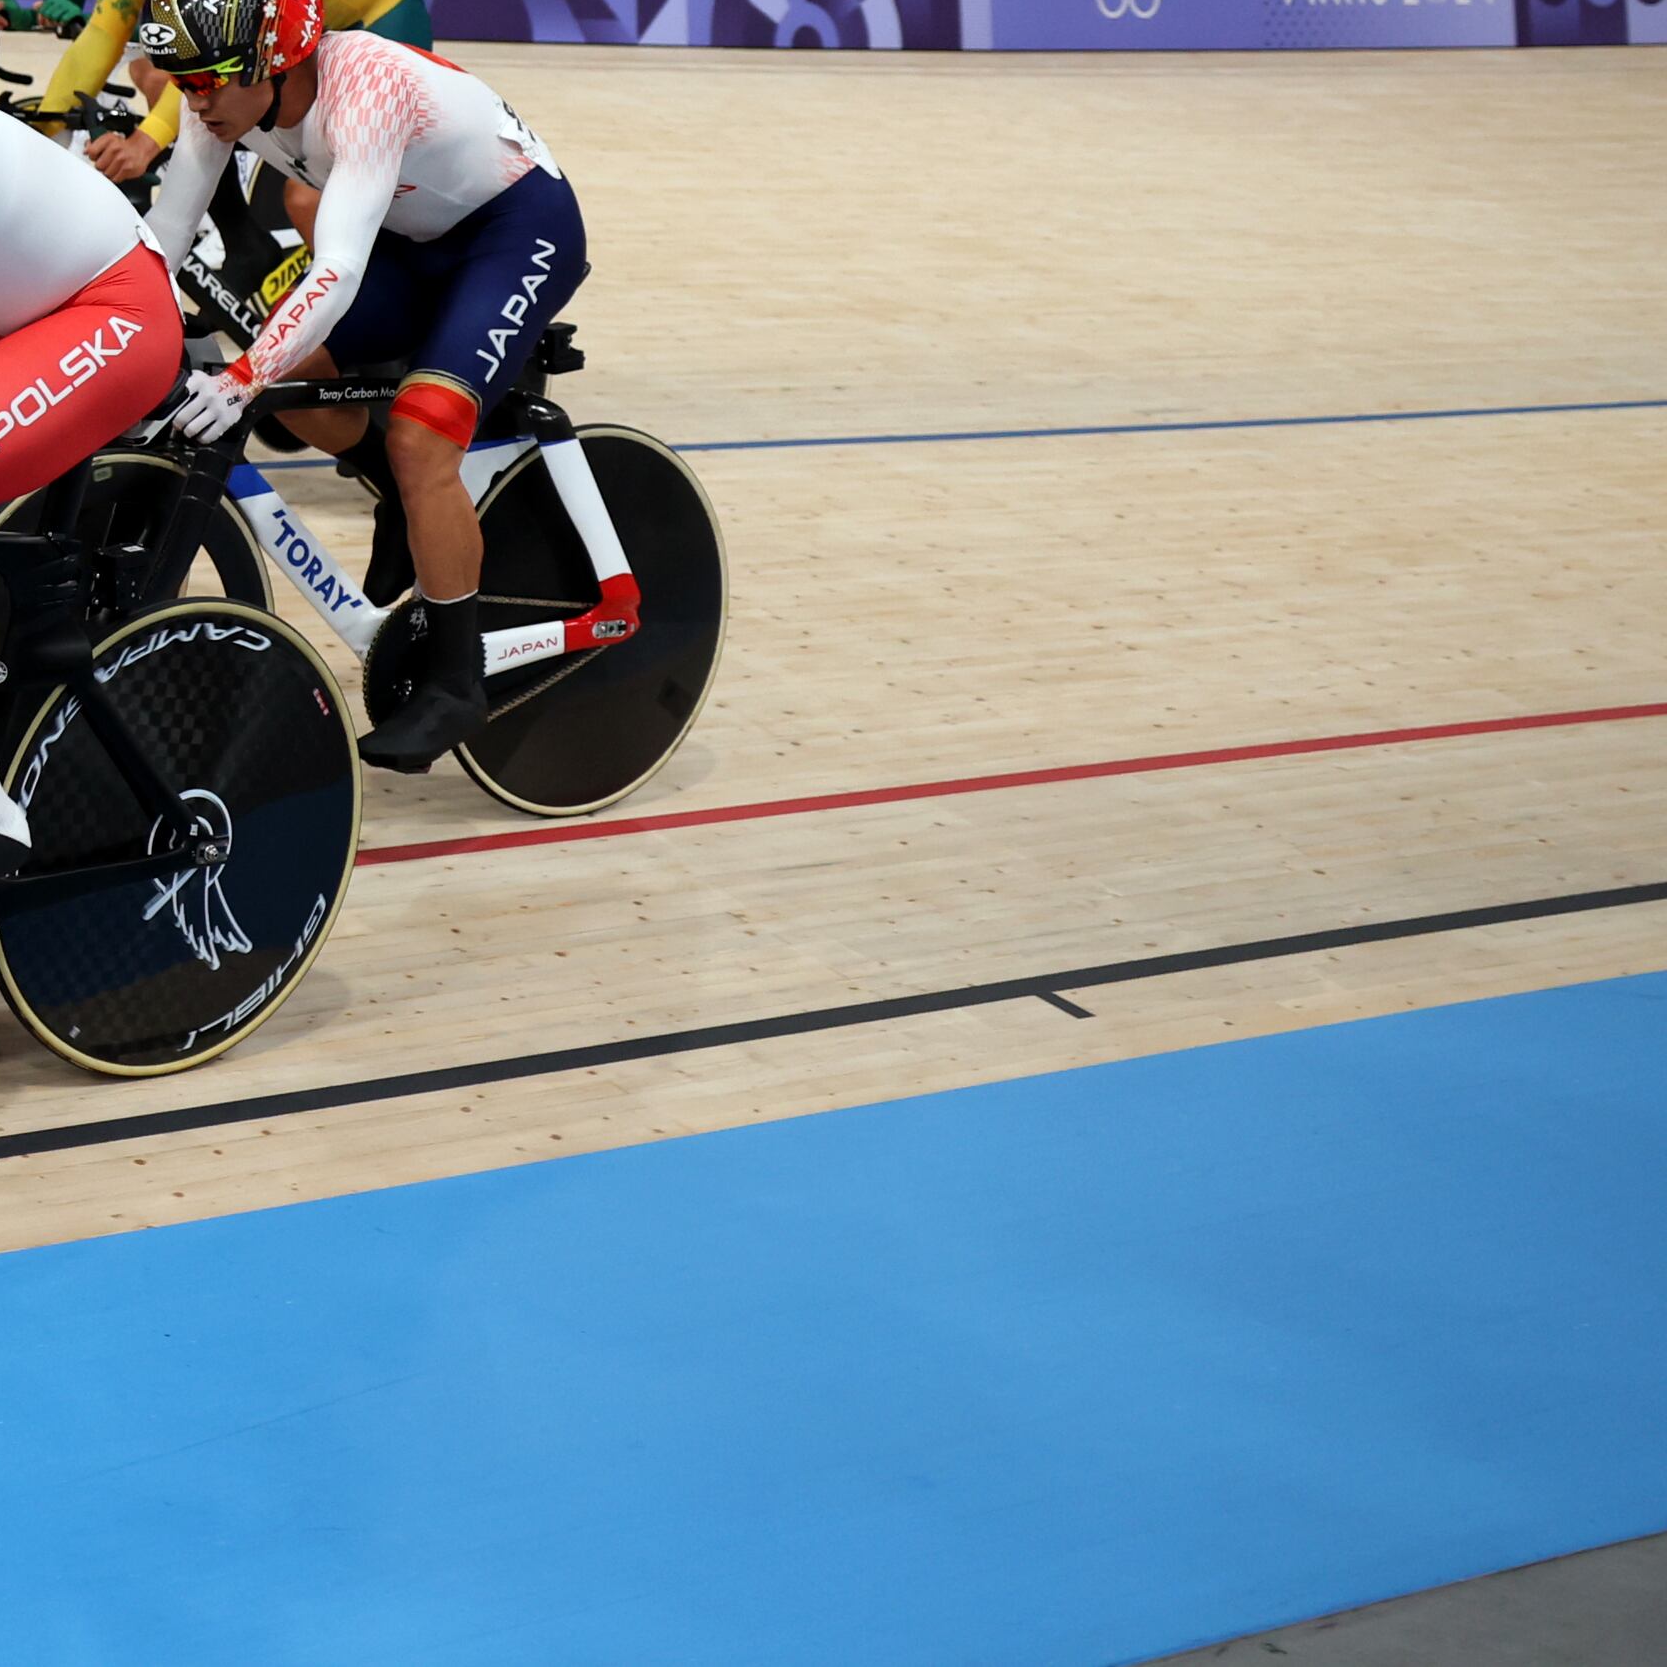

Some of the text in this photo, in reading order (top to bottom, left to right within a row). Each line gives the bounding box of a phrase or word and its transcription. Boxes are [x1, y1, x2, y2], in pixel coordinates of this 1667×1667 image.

[268, 247, 312, 299] AVIC
[268, 267, 339, 351] JAPAN
[476, 238, 556, 382] JAPAN
[318, 387, 343, 401] Toray
[344, 385, 379, 400] Carbon
[497, 636, 559, 661] JAPAN
